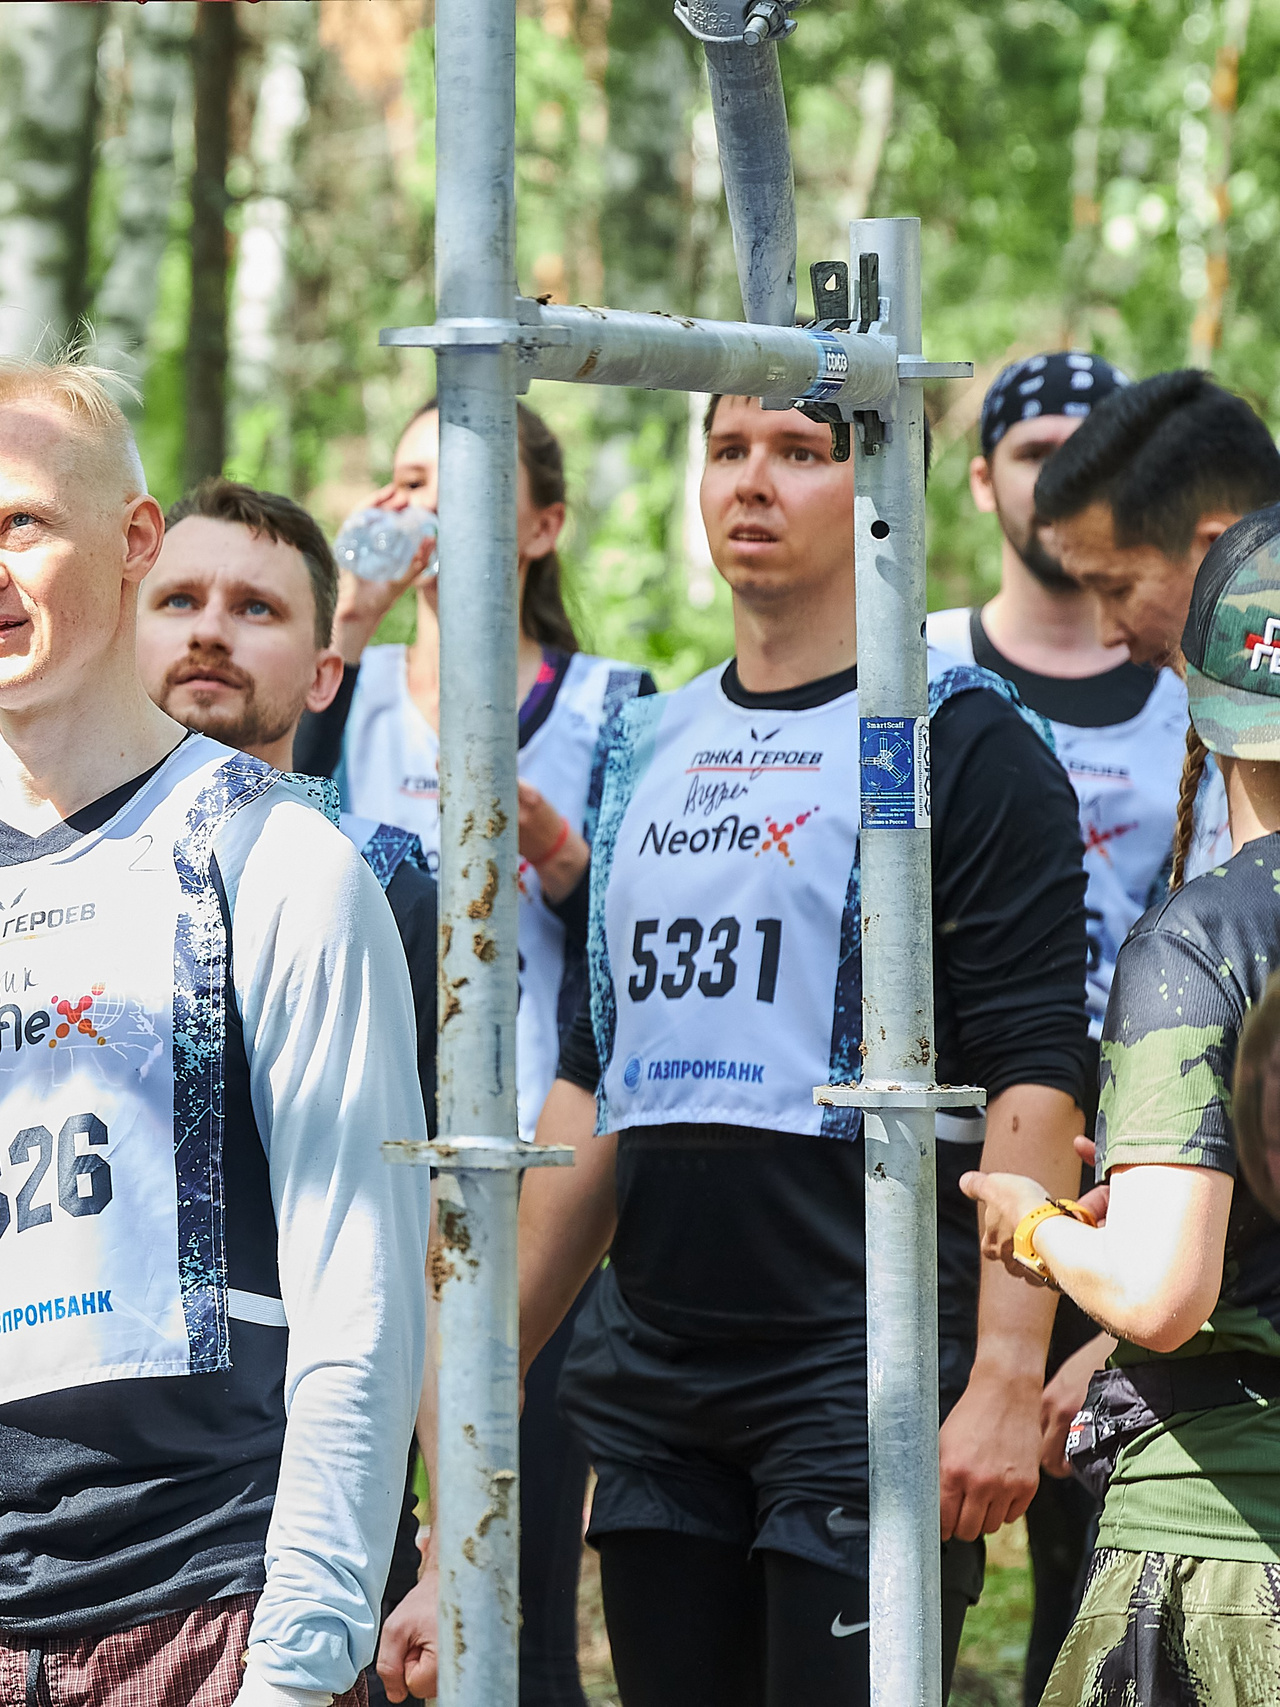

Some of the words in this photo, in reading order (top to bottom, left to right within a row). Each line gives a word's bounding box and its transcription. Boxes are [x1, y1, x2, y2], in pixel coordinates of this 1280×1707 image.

[866, 721, 905, 729] SmartScaff
[691, 749, 743, 766] ГОНКА
[750, 751, 823, 765] ГЕРОЕВ
[128, 834, 165, 871] 2
[638, 805, 820, 867] Neoflex
[3, 902, 96, 938] ГЕРОЕВ
[628, 916, 782, 1004] 5331
[647, 1059, 765, 1084] ГАЗПРОМБАНК
